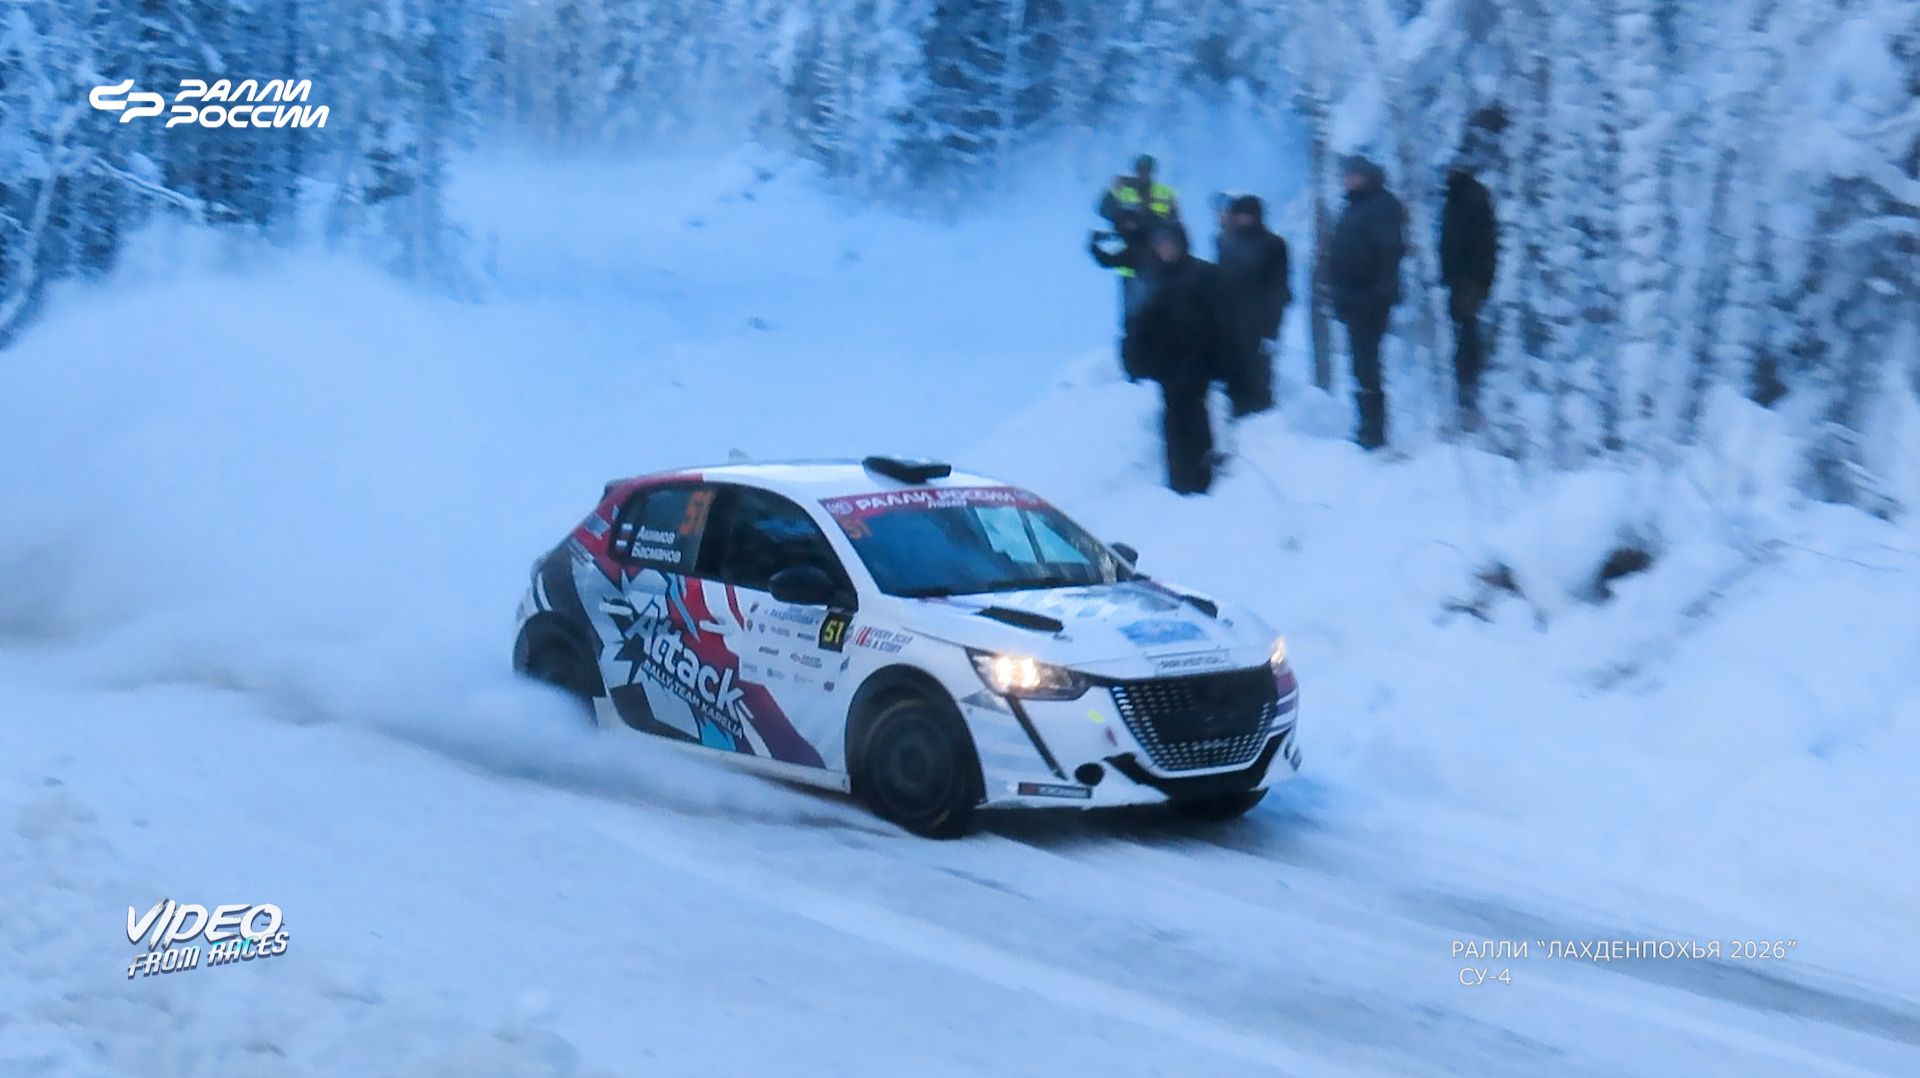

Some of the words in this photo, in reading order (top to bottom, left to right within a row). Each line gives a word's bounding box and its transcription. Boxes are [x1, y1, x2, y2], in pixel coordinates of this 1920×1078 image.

[631, 541, 682, 563] Басманов
[823, 618, 846, 644] 51
[624, 608, 745, 722] Attack
[699, 700, 744, 740] KARELIA
